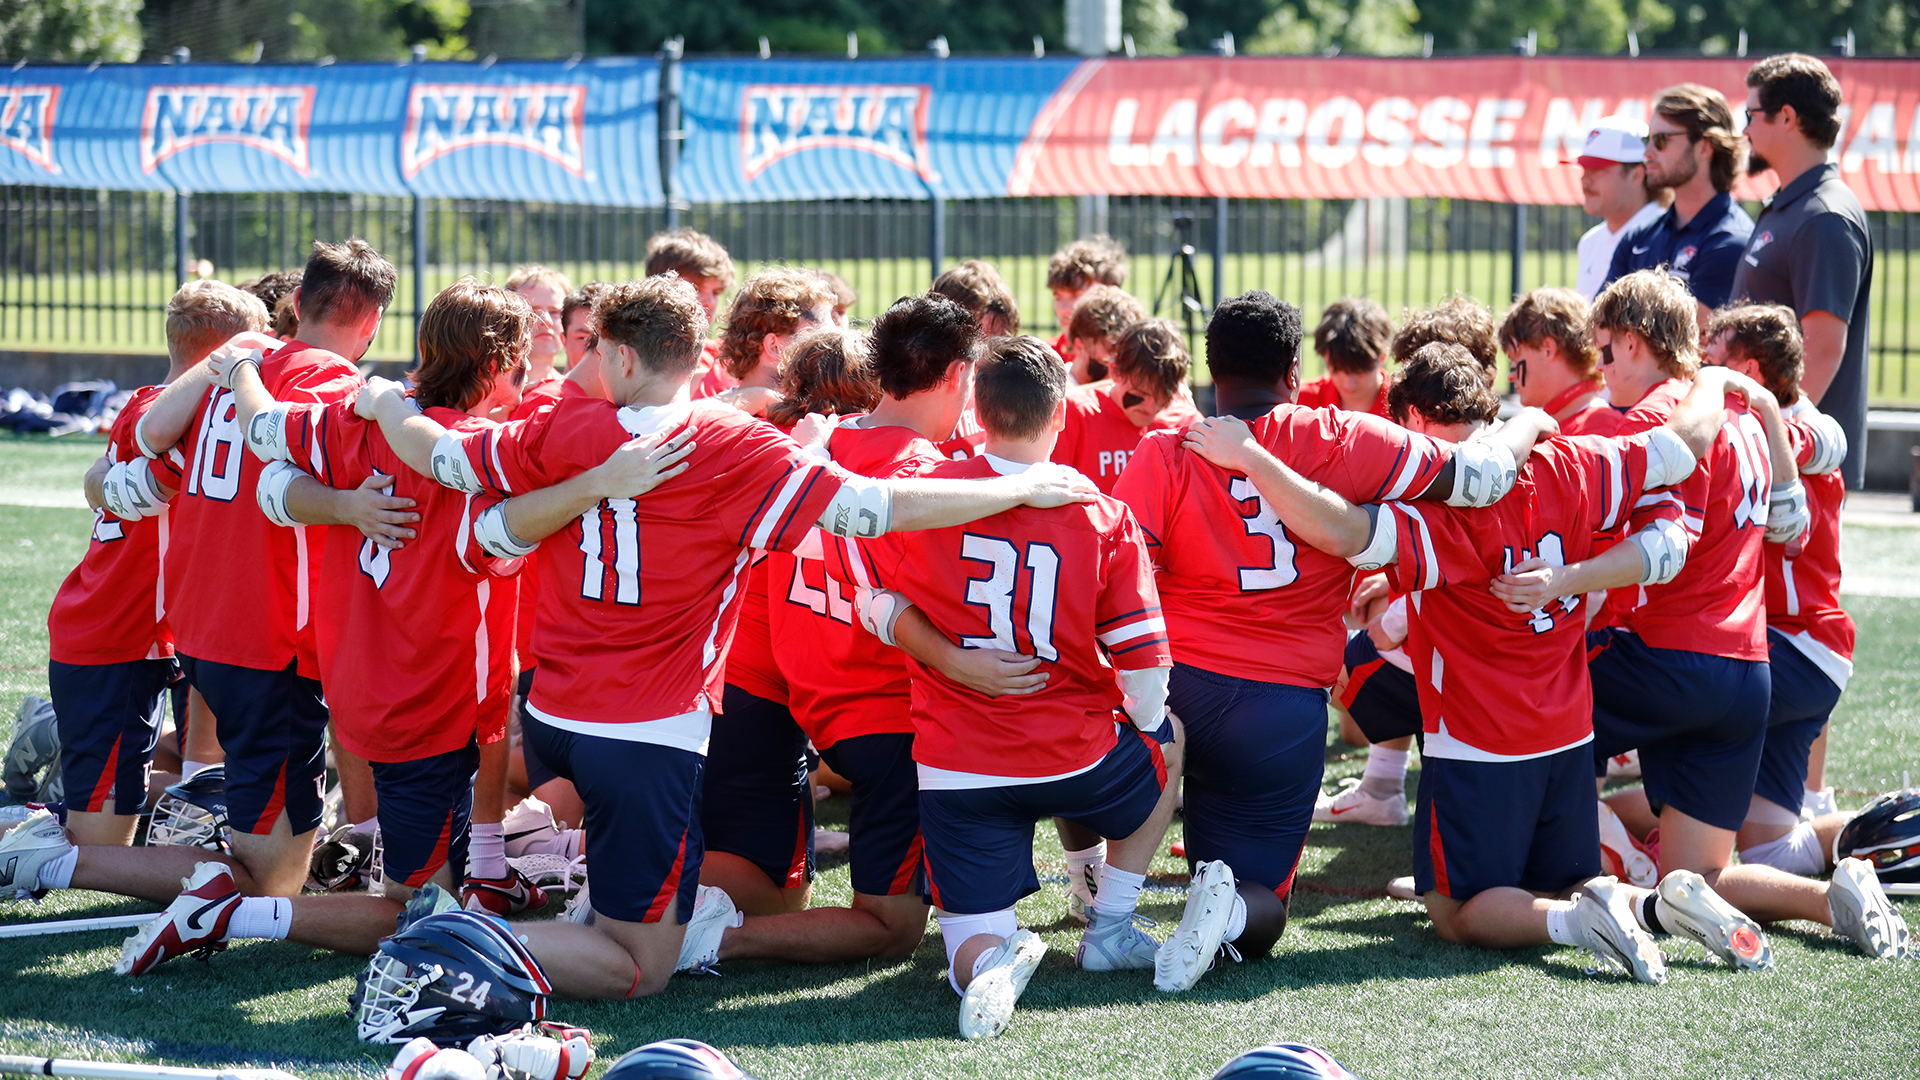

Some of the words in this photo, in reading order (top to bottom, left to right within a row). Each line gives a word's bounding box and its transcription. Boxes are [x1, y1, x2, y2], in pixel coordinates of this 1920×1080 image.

[147, 91, 305, 165] NAIA
[408, 90, 579, 170] NAIA
[747, 91, 922, 170] NAIA
[1107, 96, 1527, 169] LACROSSE
[187, 386, 246, 504] 18
[578, 497, 642, 606] 11
[958, 531, 1061, 664] 31
[450, 971, 492, 1010] 24
